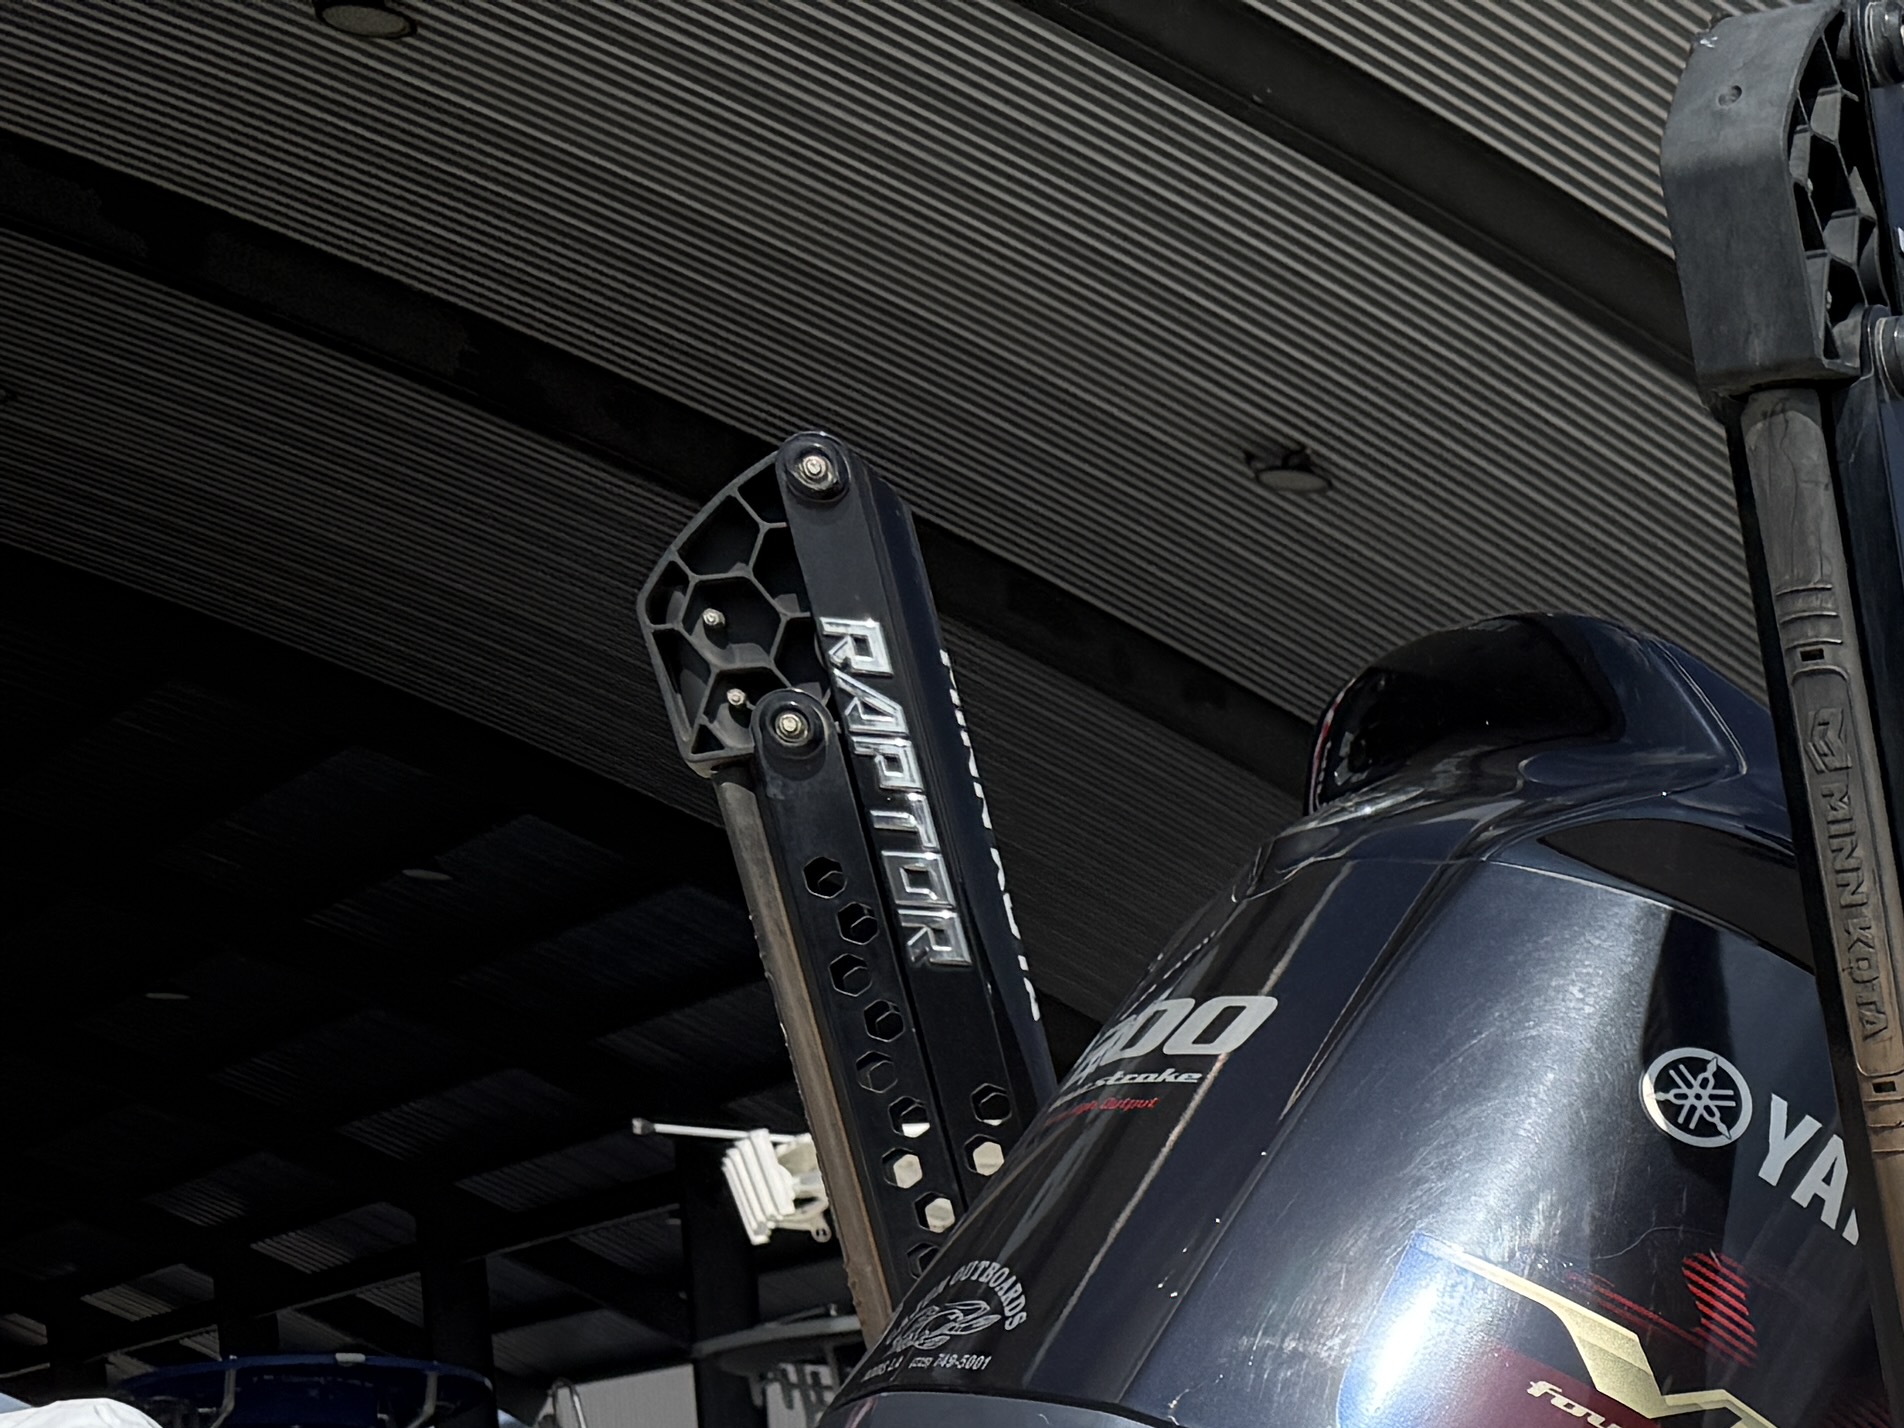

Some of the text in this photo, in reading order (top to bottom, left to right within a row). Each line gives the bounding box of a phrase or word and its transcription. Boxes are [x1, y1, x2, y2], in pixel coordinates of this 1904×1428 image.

[818, 616, 973, 967] RAPTOR
[1820, 783, 1889, 1043] MINN KOTA
[949, 1260, 1028, 1331] OUTBOARDS
